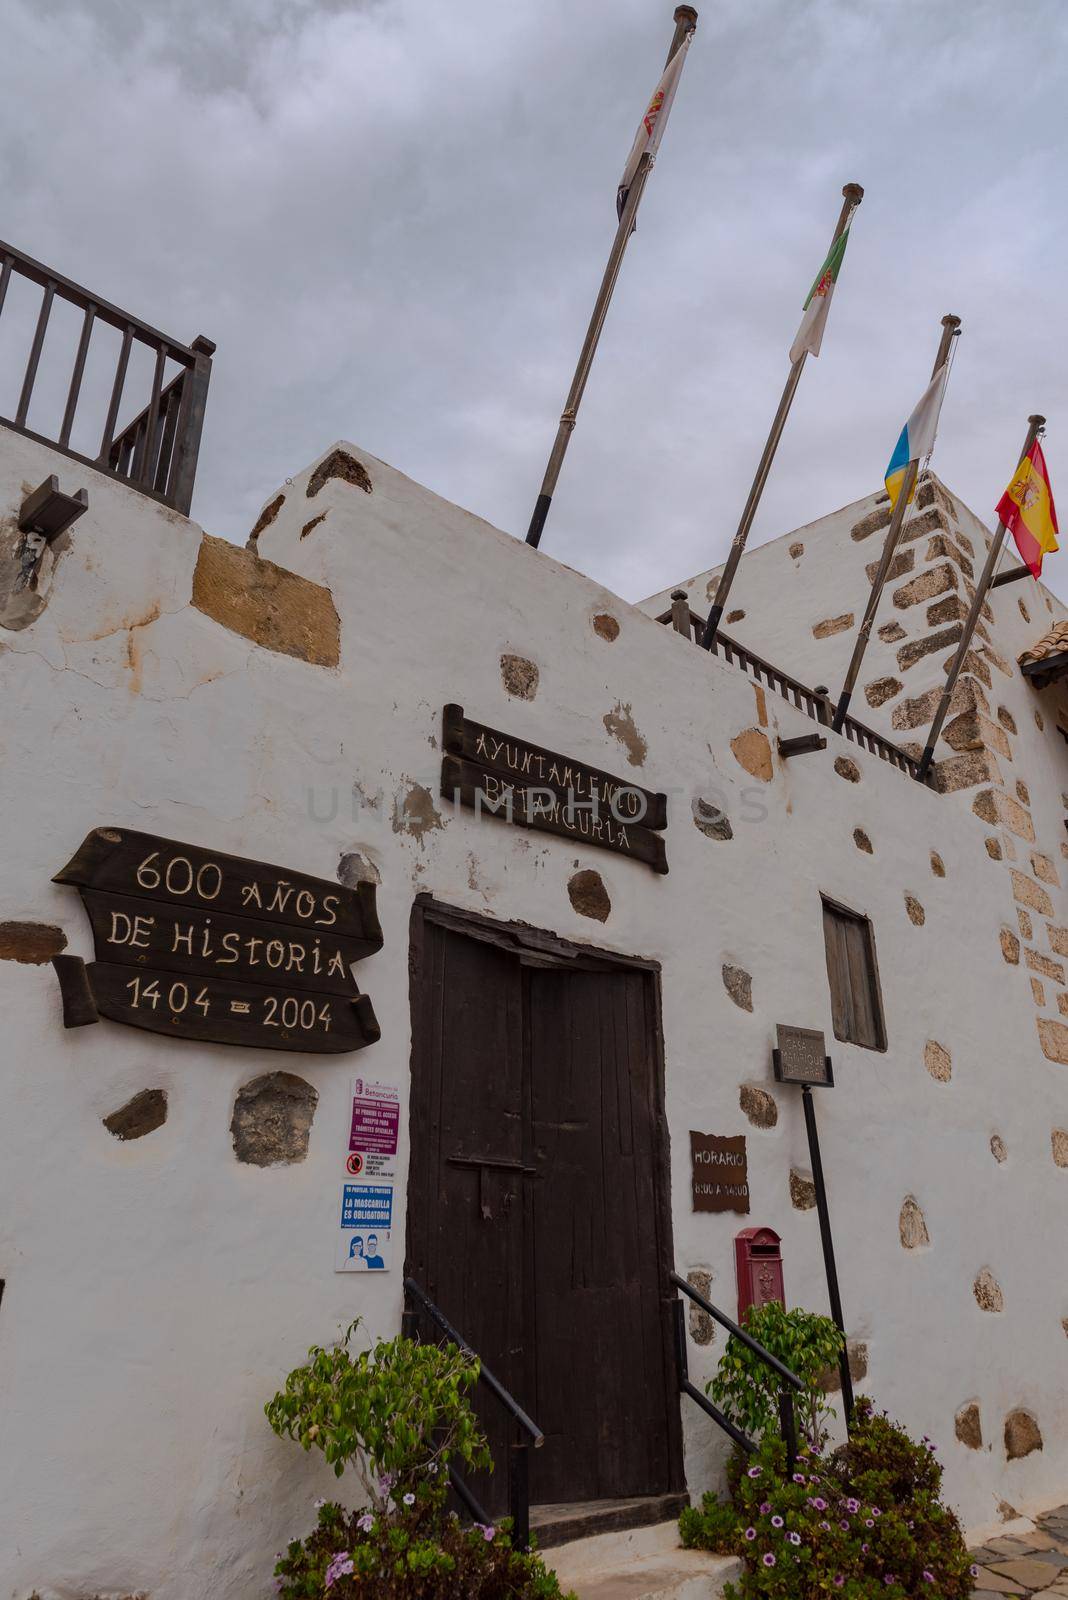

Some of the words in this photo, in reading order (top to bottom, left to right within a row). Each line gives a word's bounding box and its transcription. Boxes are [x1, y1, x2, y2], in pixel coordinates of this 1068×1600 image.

[136, 852, 223, 899] 600
[241, 880, 340, 925] AÑOS
[107, 911, 155, 948] DE
[126, 976, 211, 1016] 1404
[263, 996, 332, 1031] 2004
[695, 1150, 744, 1166] HORARIO
[344, 1209, 353, 1219] ES
[353, 1210, 390, 1220] OBLIGATORIA
[345, 1198, 353, 1208] LA
[354, 1198, 390, 1209] MASCARILLA
